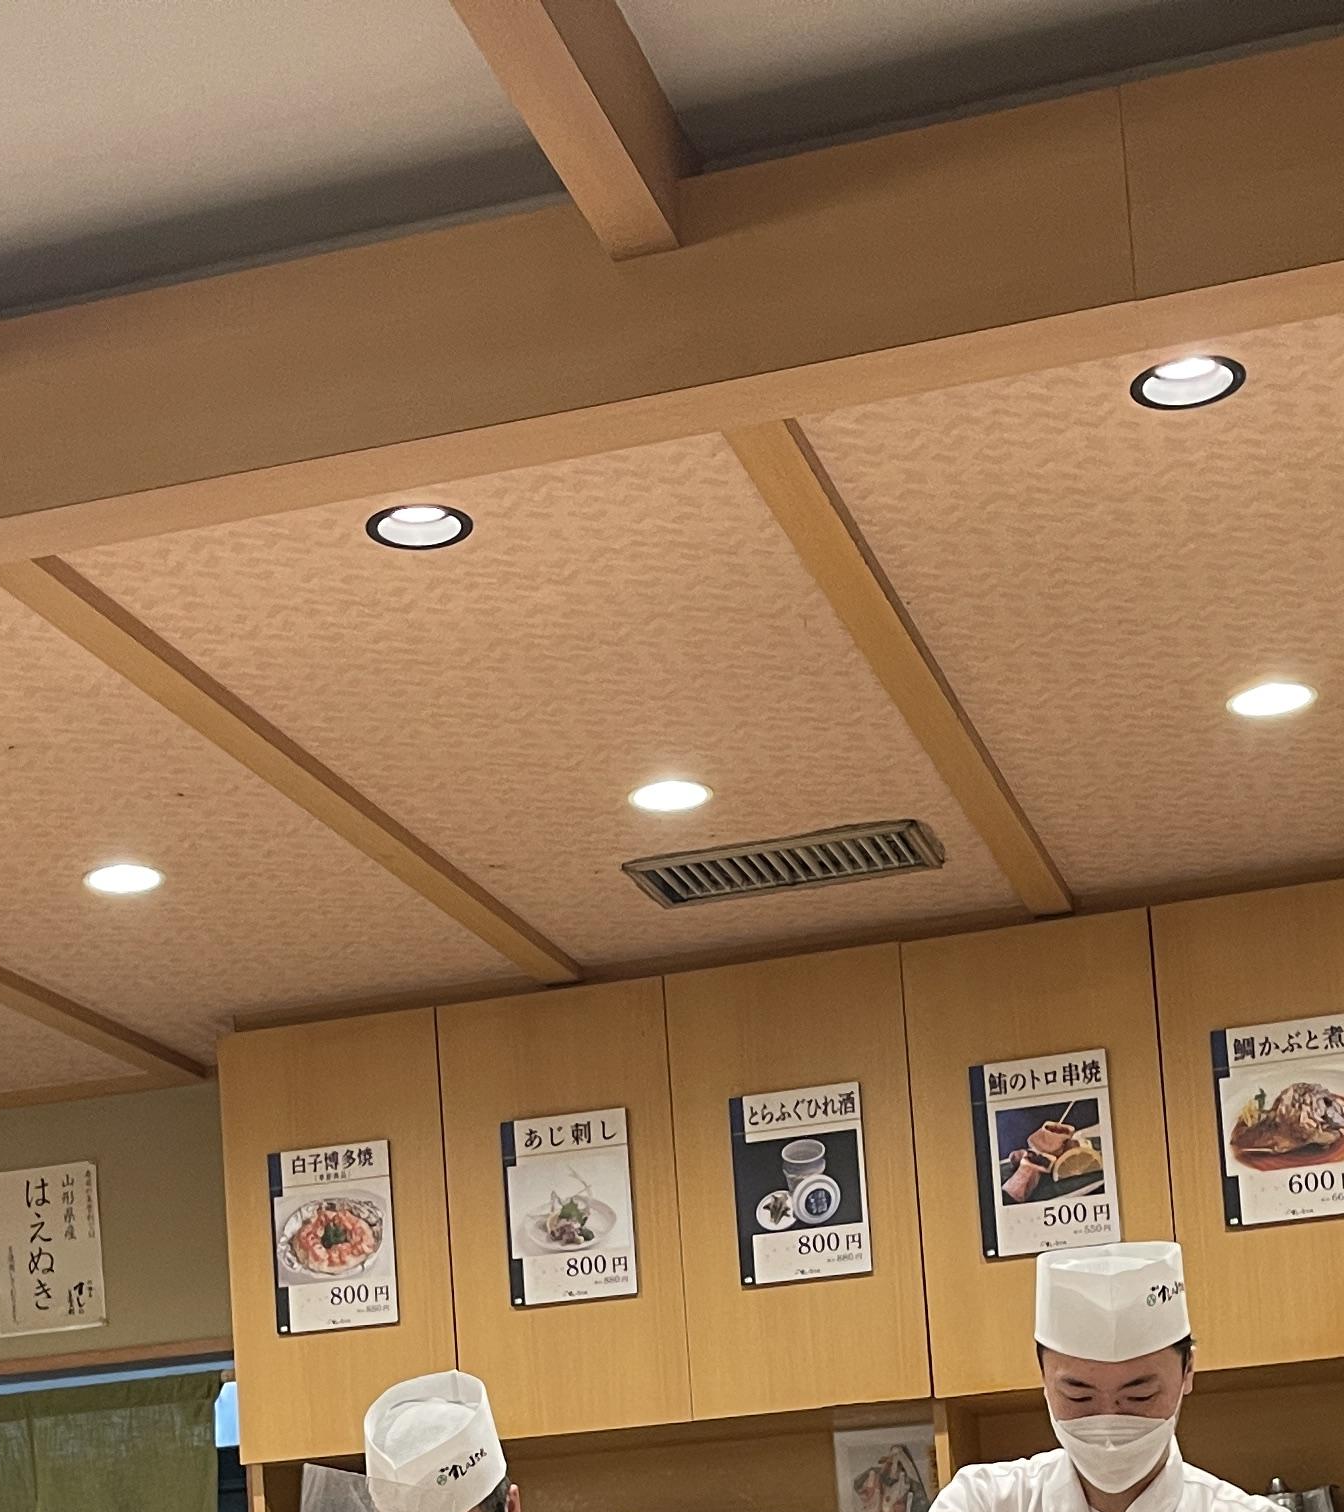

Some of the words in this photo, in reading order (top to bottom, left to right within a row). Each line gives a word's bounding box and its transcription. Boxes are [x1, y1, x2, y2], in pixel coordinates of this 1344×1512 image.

[1233, 1025, 1344, 1061] 鯛かぶと煮
[988, 1060, 1102, 1096] 鮪のトロ串焼
[748, 1091, 856, 1125] とらふぐひれ酒
[524, 1121, 617, 1150] あじ刺し
[291, 1147, 374, 1175] 白子博多焼
[1043, 1203, 1111, 1227] 500円
[25, 1178, 55, 1311] はえぬき
[798, 1232, 862, 1255] 800円
[566, 1254, 628, 1277] 800円
[330, 1284, 390, 1306] 800円
